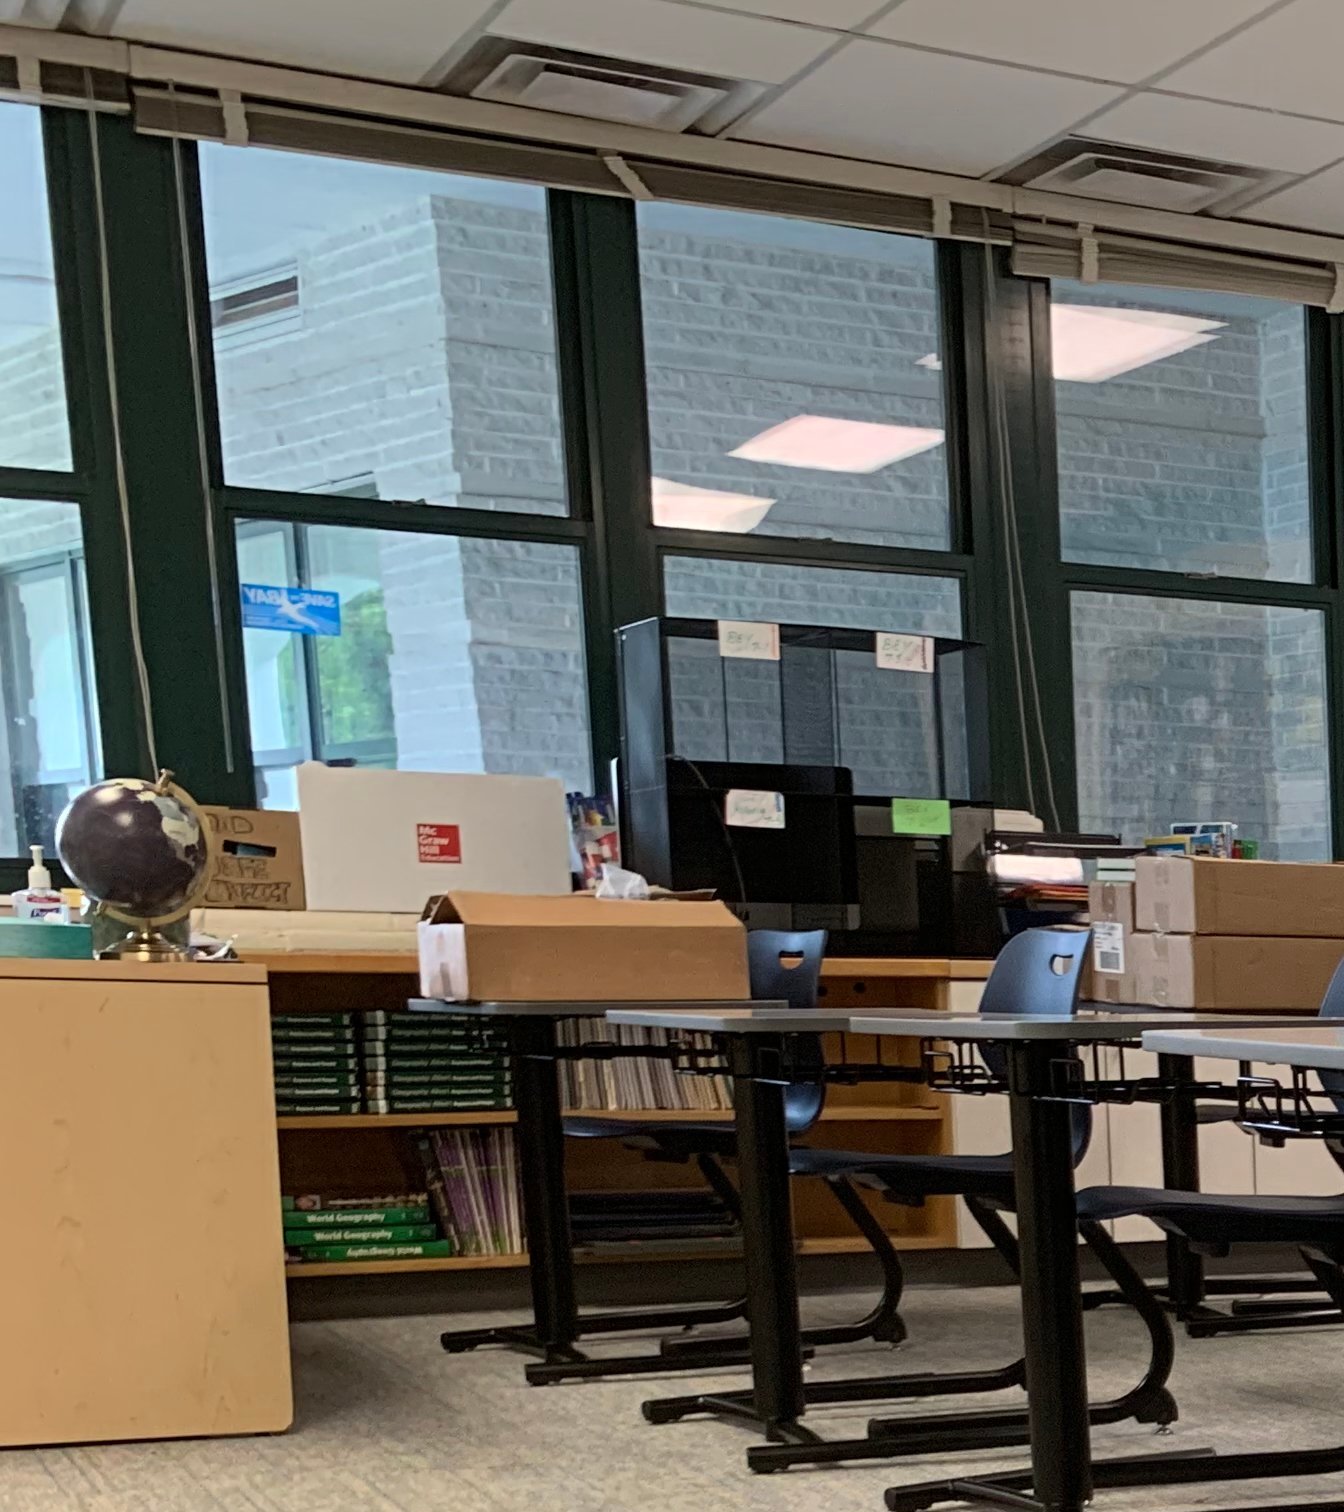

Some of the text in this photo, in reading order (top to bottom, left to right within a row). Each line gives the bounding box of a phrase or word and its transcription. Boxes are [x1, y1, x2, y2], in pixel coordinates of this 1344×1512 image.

[306, 1212, 386, 1224] World Geography
[313, 1230, 393, 1241] World Geography
